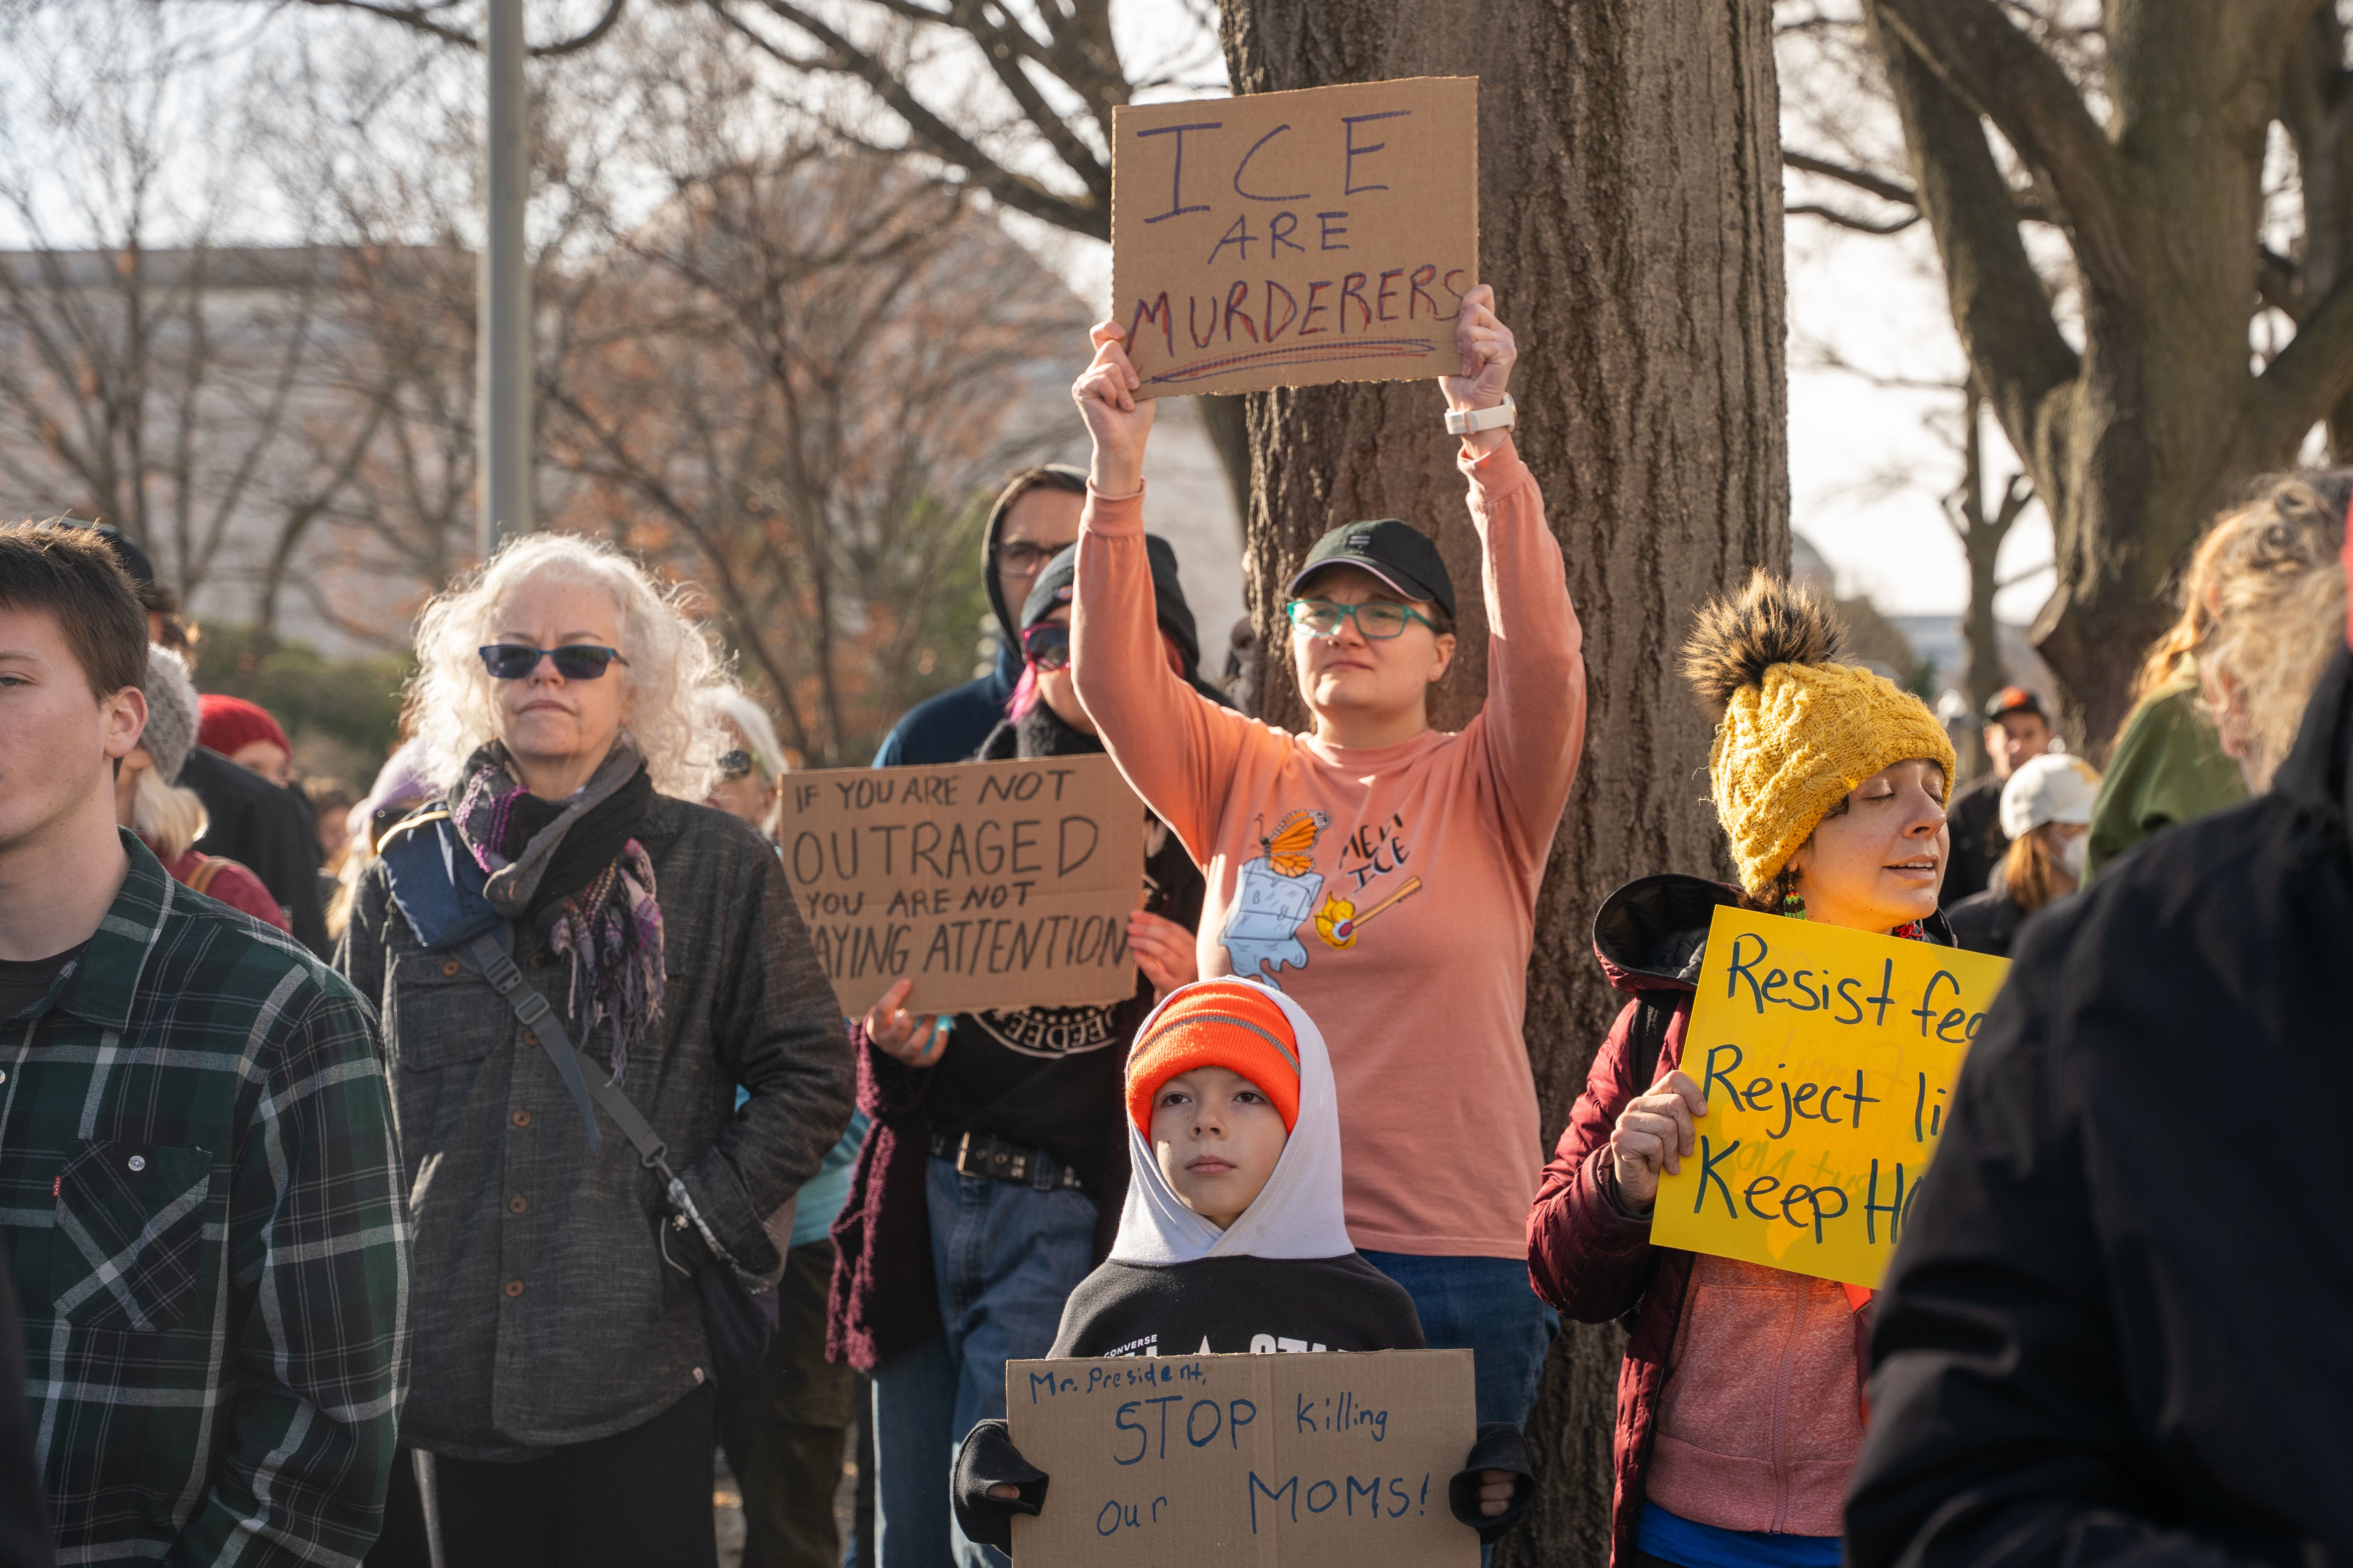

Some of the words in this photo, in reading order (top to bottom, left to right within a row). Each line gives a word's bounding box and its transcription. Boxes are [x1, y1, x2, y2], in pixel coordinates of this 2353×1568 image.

[1137, 109, 1412, 224] ICE
[1208, 211, 1350, 264] ARE
[1124, 264, 1465, 358] MURDERERS
[796, 784, 819, 813] IF
[835, 778, 894, 810] YOU
[900, 775, 960, 805] ARE
[978, 770, 1076, 803] NOT
[794, 815, 1099, 885] OUTRAGED
[1346, 836, 1411, 896] ICE
[806, 890, 863, 919] YOU
[887, 888, 950, 918] ARE
[961, 880, 1036, 910] NOT
[806, 923, 911, 979] AYING
[922, 915, 1130, 976] ATTENTION
[1727, 933, 1895, 1026] Resist
[1703, 1044, 1881, 1139] Reject
[1694, 1134, 1848, 1244] Keep
[1104, 1334, 1158, 1358] CONVERSE
[1030, 1371, 1078, 1404] Mr.
[1113, 1395, 1257, 1466] STOP
[1248, 1471, 1430, 1534] MOMS!
